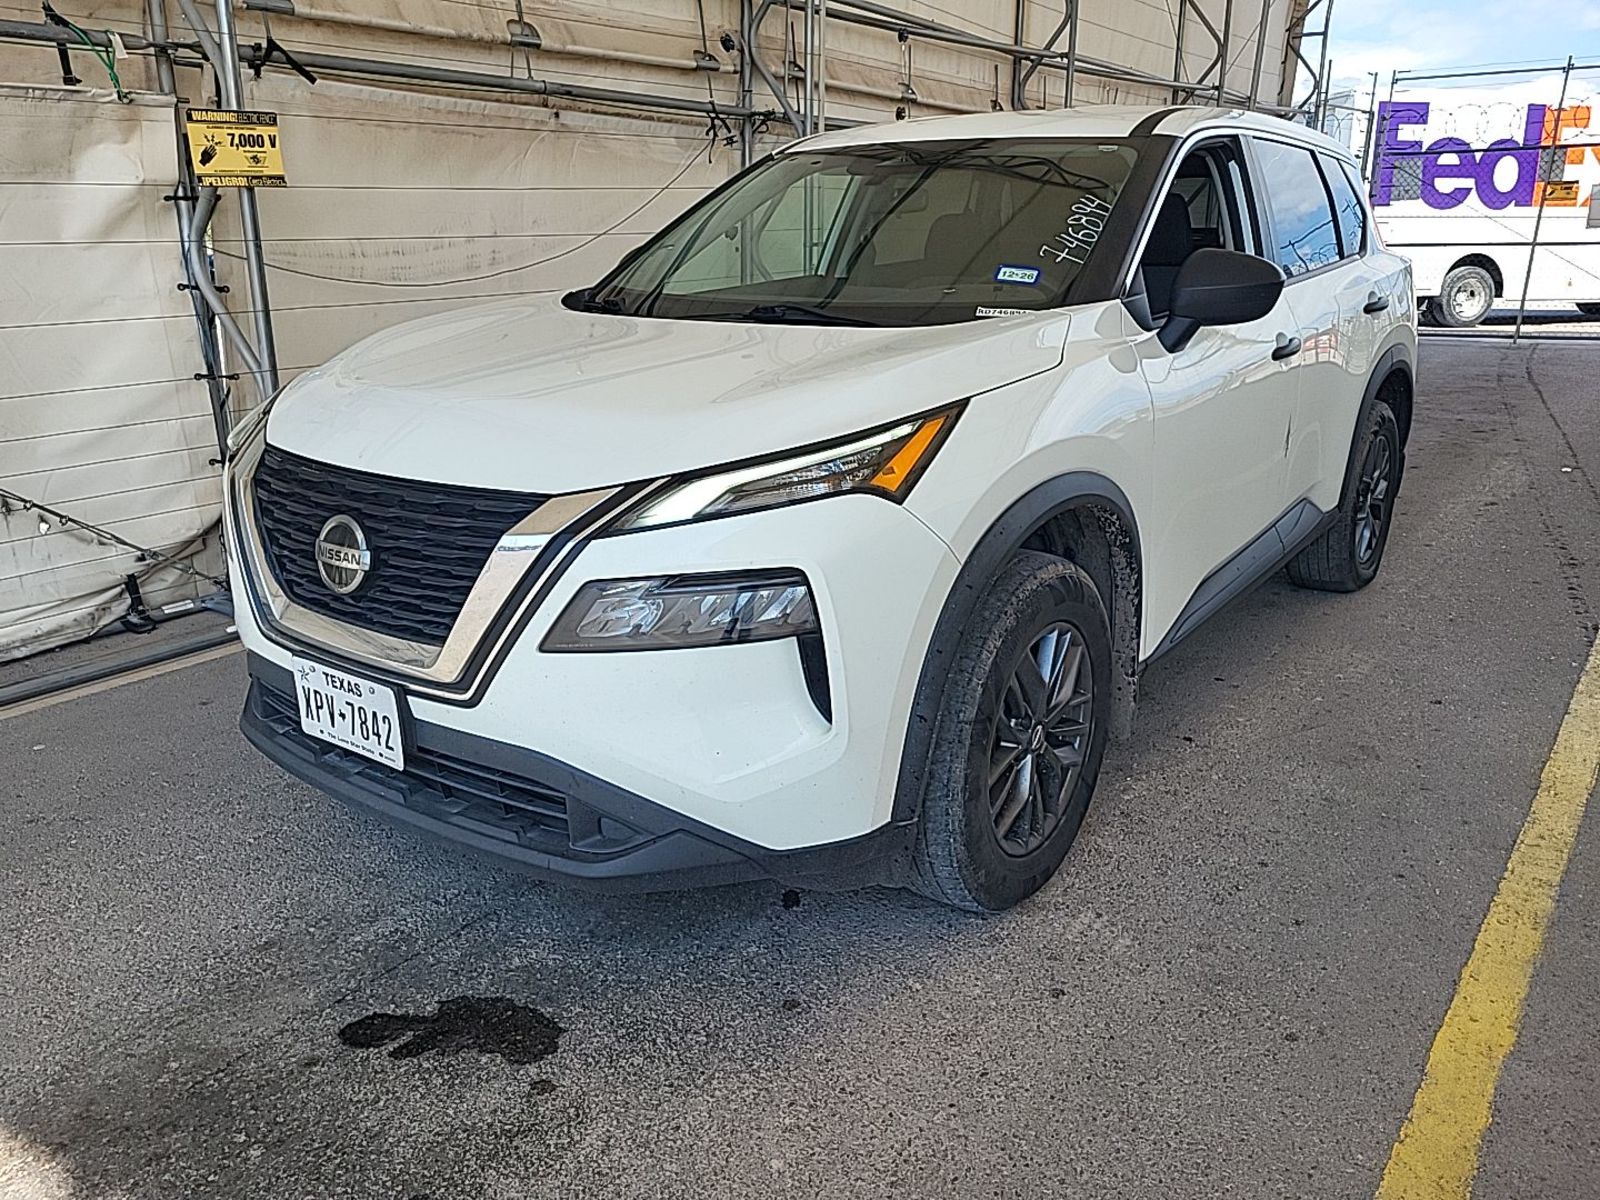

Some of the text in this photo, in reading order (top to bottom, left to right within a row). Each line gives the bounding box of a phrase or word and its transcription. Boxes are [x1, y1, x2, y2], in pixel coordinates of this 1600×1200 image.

[191, 110, 238, 122] WARNING!
[226, 132, 277, 151] 7,000 V
[319, 543, 361, 566] NISSAN
[321, 671, 362, 697] TEXAS
[301, 685, 395, 752] XPV 7842
